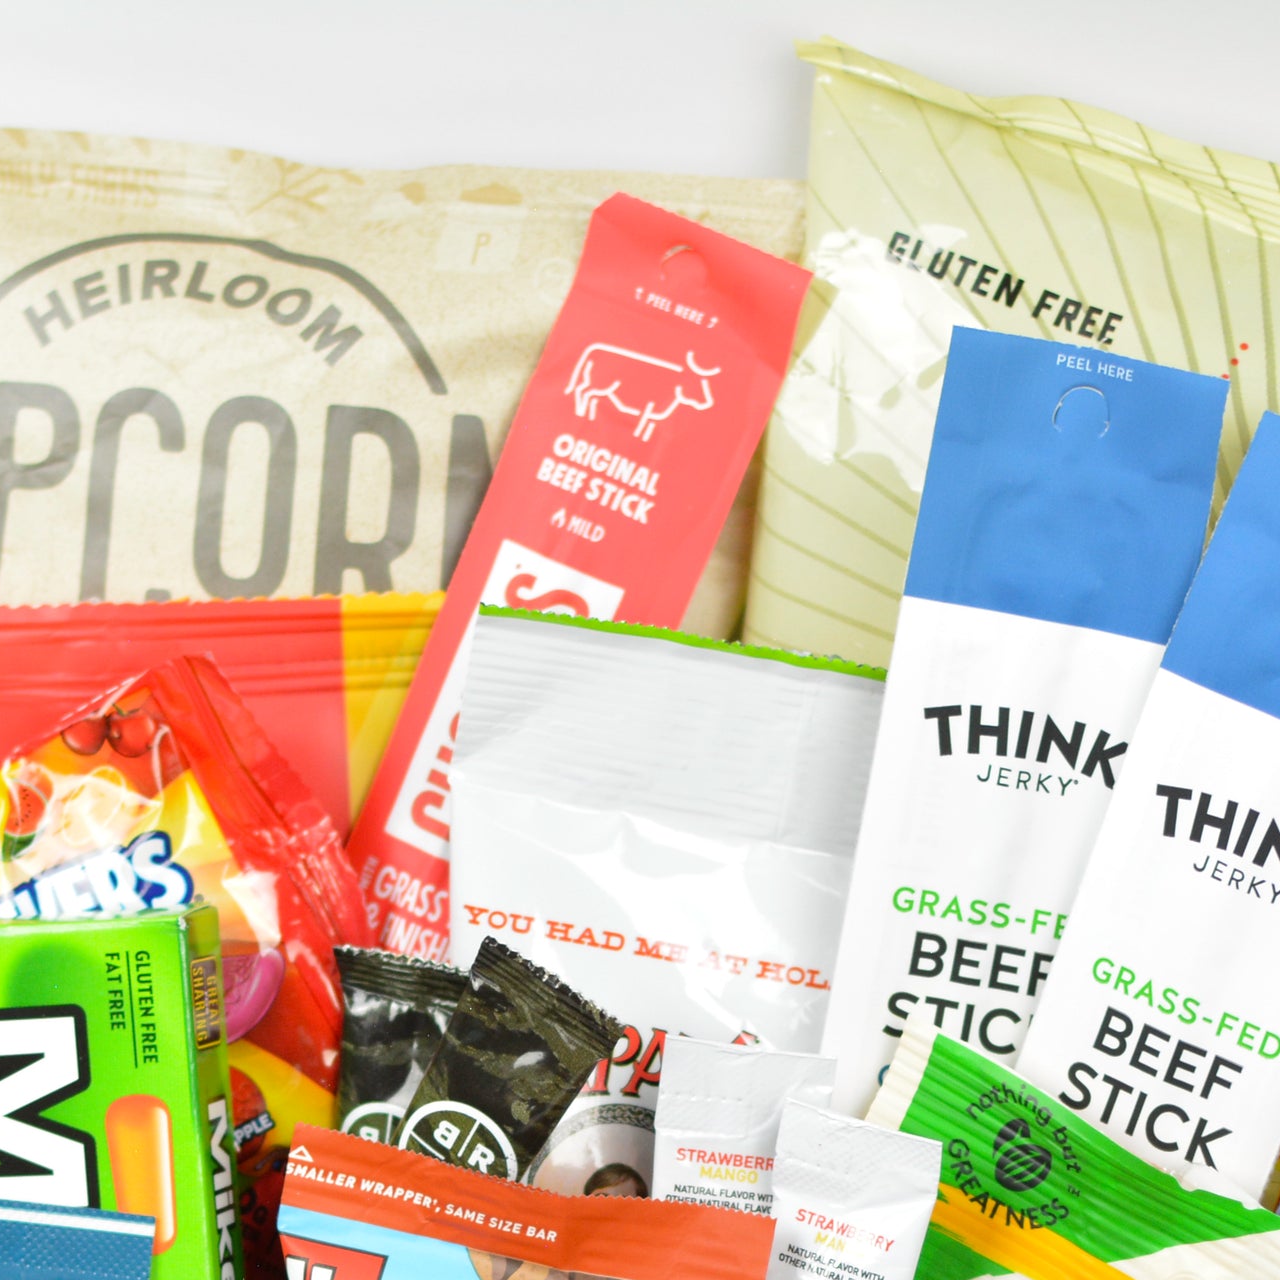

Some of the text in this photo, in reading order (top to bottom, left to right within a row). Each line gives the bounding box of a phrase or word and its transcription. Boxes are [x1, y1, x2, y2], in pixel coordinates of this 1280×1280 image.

[23, 257, 363, 367] HEIRLOOM
[887, 231, 1124, 345] GLUTEN FREE
[1056, 353, 1134, 382] PEEL HERE
[537, 457, 656, 524] BEEF STICK
[553, 433, 661, 496] ORIGINAL
[567, 515, 606, 542] MILD
[923, 704, 1129, 790] THINK
[976, 763, 1075, 797] JERKY
[892, 885, 1067, 940] GRASS-FE
[463, 904, 832, 991] YOU HAD ME AT HOL
[908, 930, 1056, 998] BEEF
[104, 951, 127, 1032] FAT FREE
[134, 949, 159, 1066] GLUTEN FREE
[882, 991, 1036, 1054] STIC
[1093, 1006, 1244, 1100] BEEF
[966, 1081, 1082, 1174] nothing but
[1058, 1061, 1233, 1172] STICK
[674, 1183, 755, 1202] NATURAL FLAVOR
[676, 1147, 775, 1173] STRAWBERR
[699, 1164, 760, 1186] MANGO
[948, 1138, 1070, 1230] GREATNESS
[285, 1161, 558, 1243] SMALLER SAME SIZE BAR
[778, 1252, 807, 1271] OTHER
[787, 1243, 826, 1266] NATURAL
[828, 1259, 860, 1278] FLAVOR
